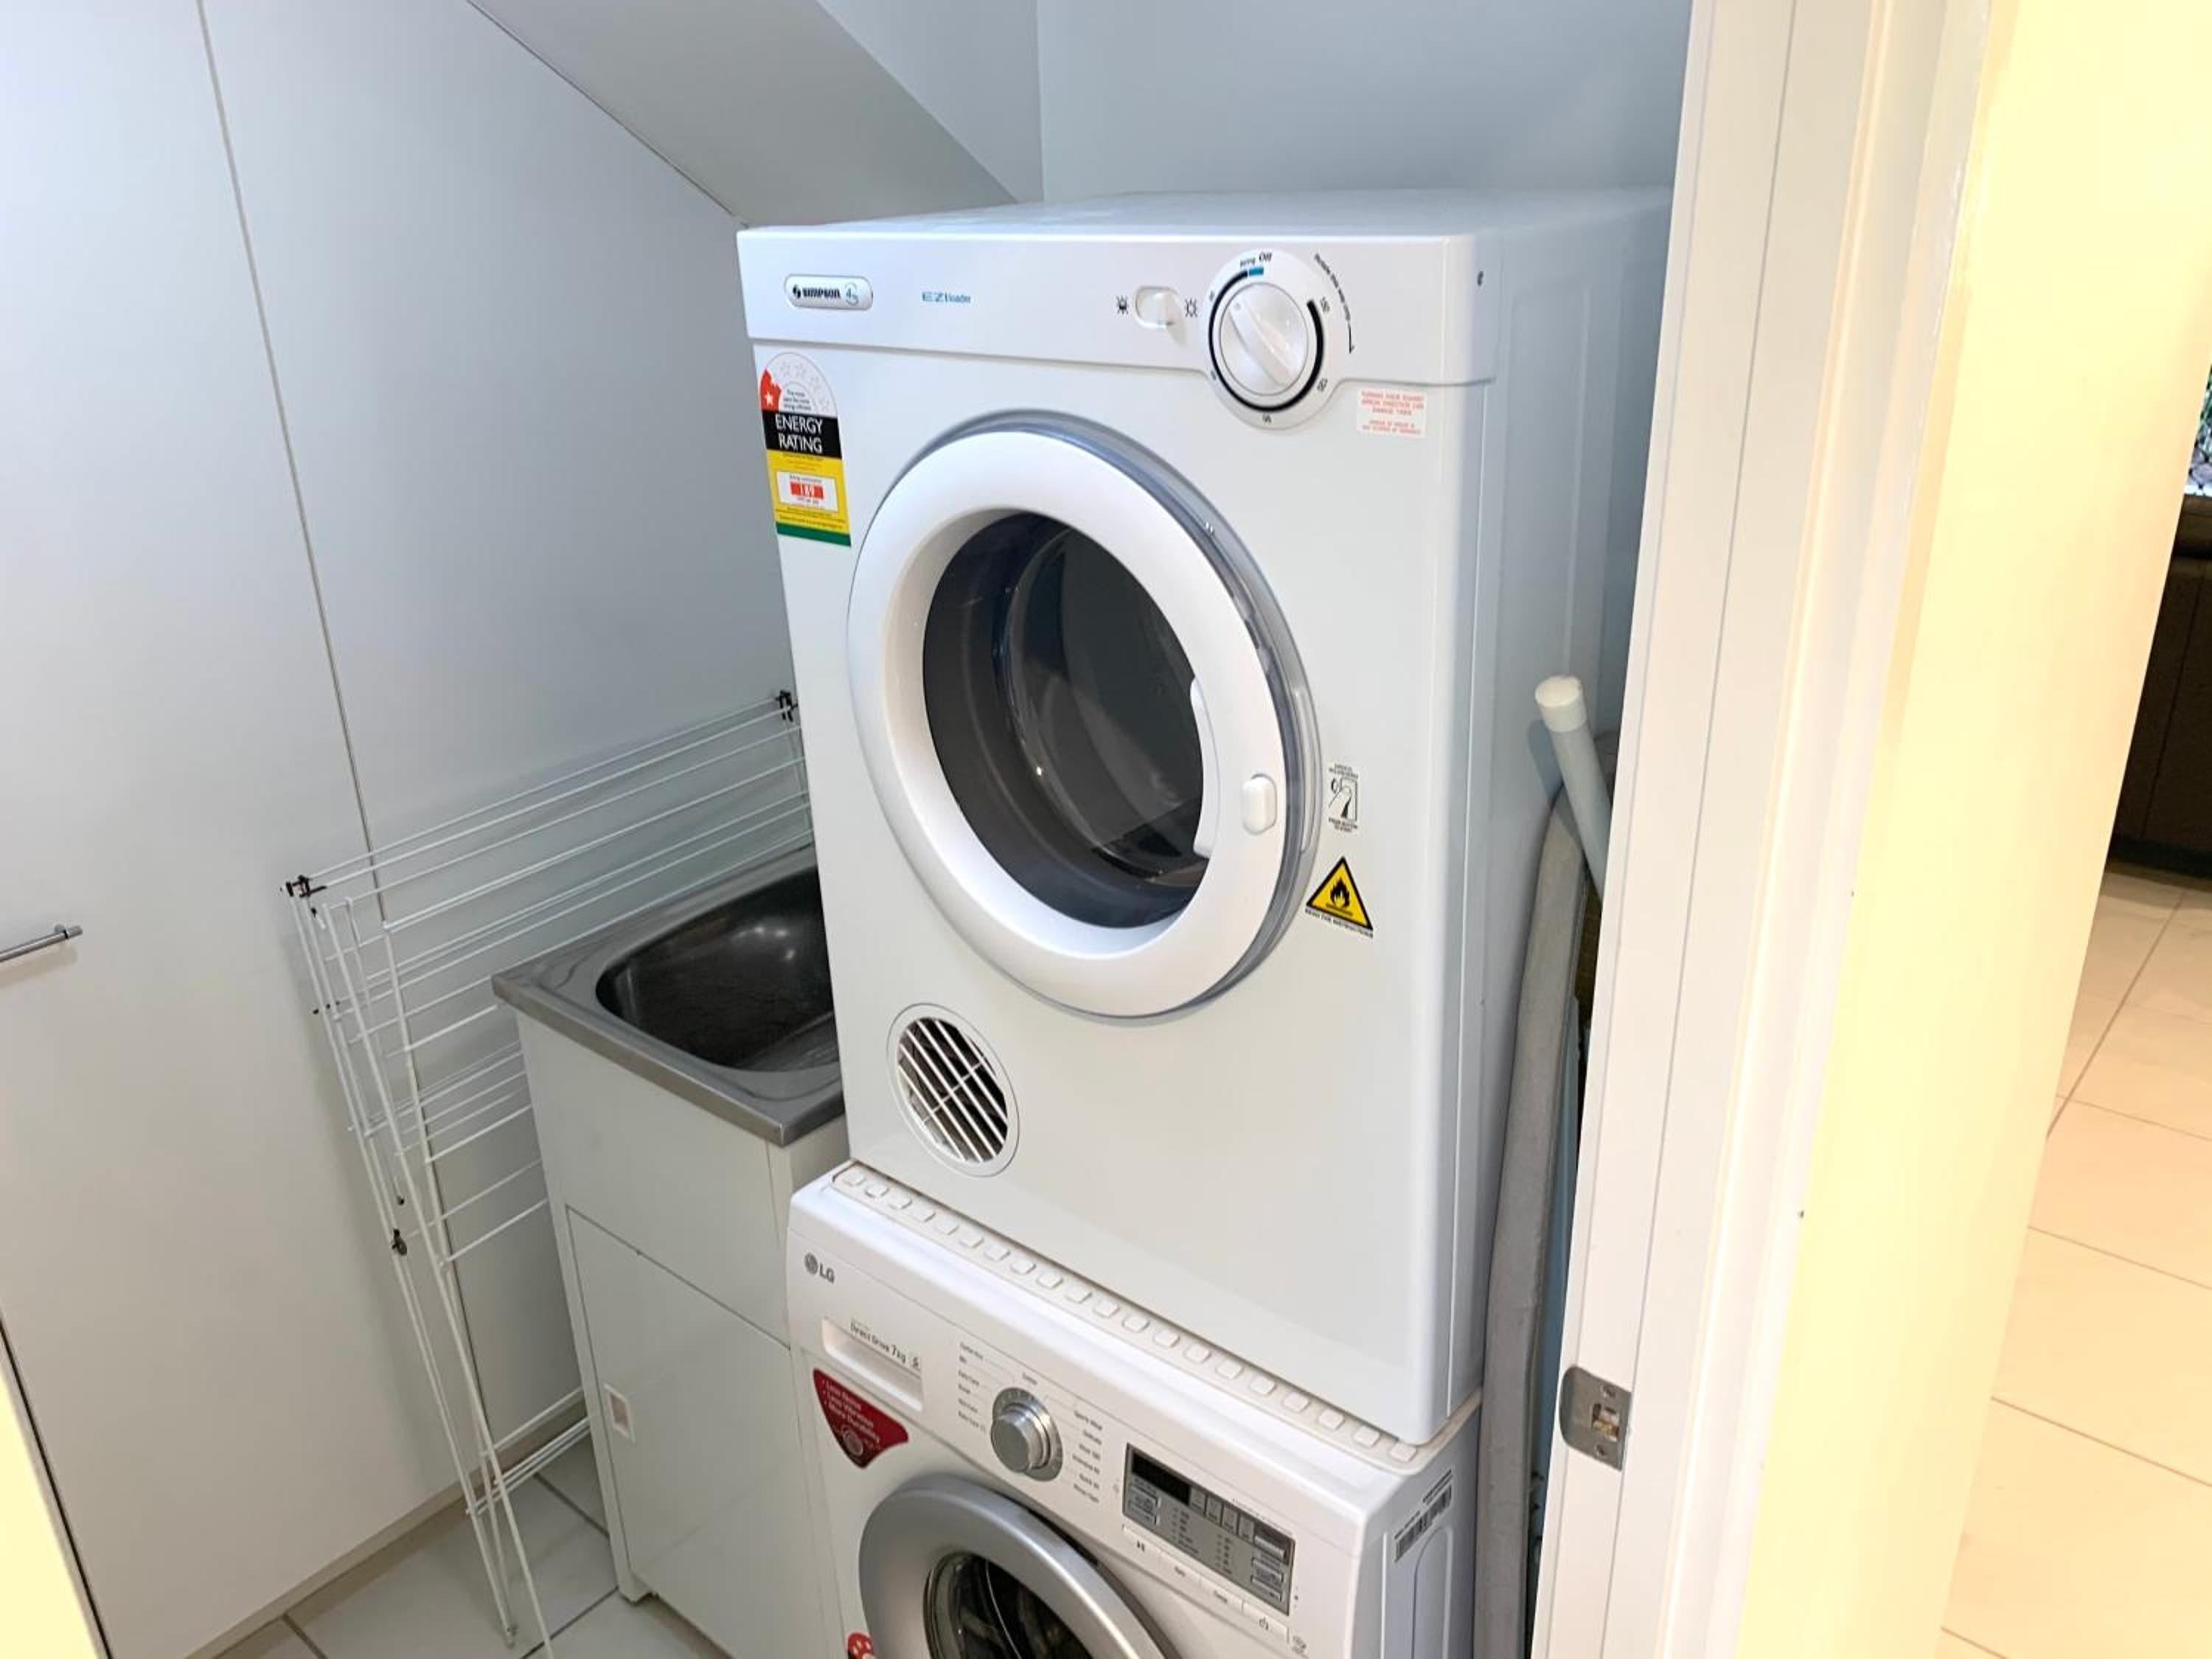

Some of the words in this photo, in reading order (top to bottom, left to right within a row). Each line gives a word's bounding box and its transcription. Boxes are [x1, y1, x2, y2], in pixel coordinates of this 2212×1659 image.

[776, 414, 823, 435] ENERGY
[778, 433, 822, 453] RATING
[819, 1262, 835, 1284] LG
